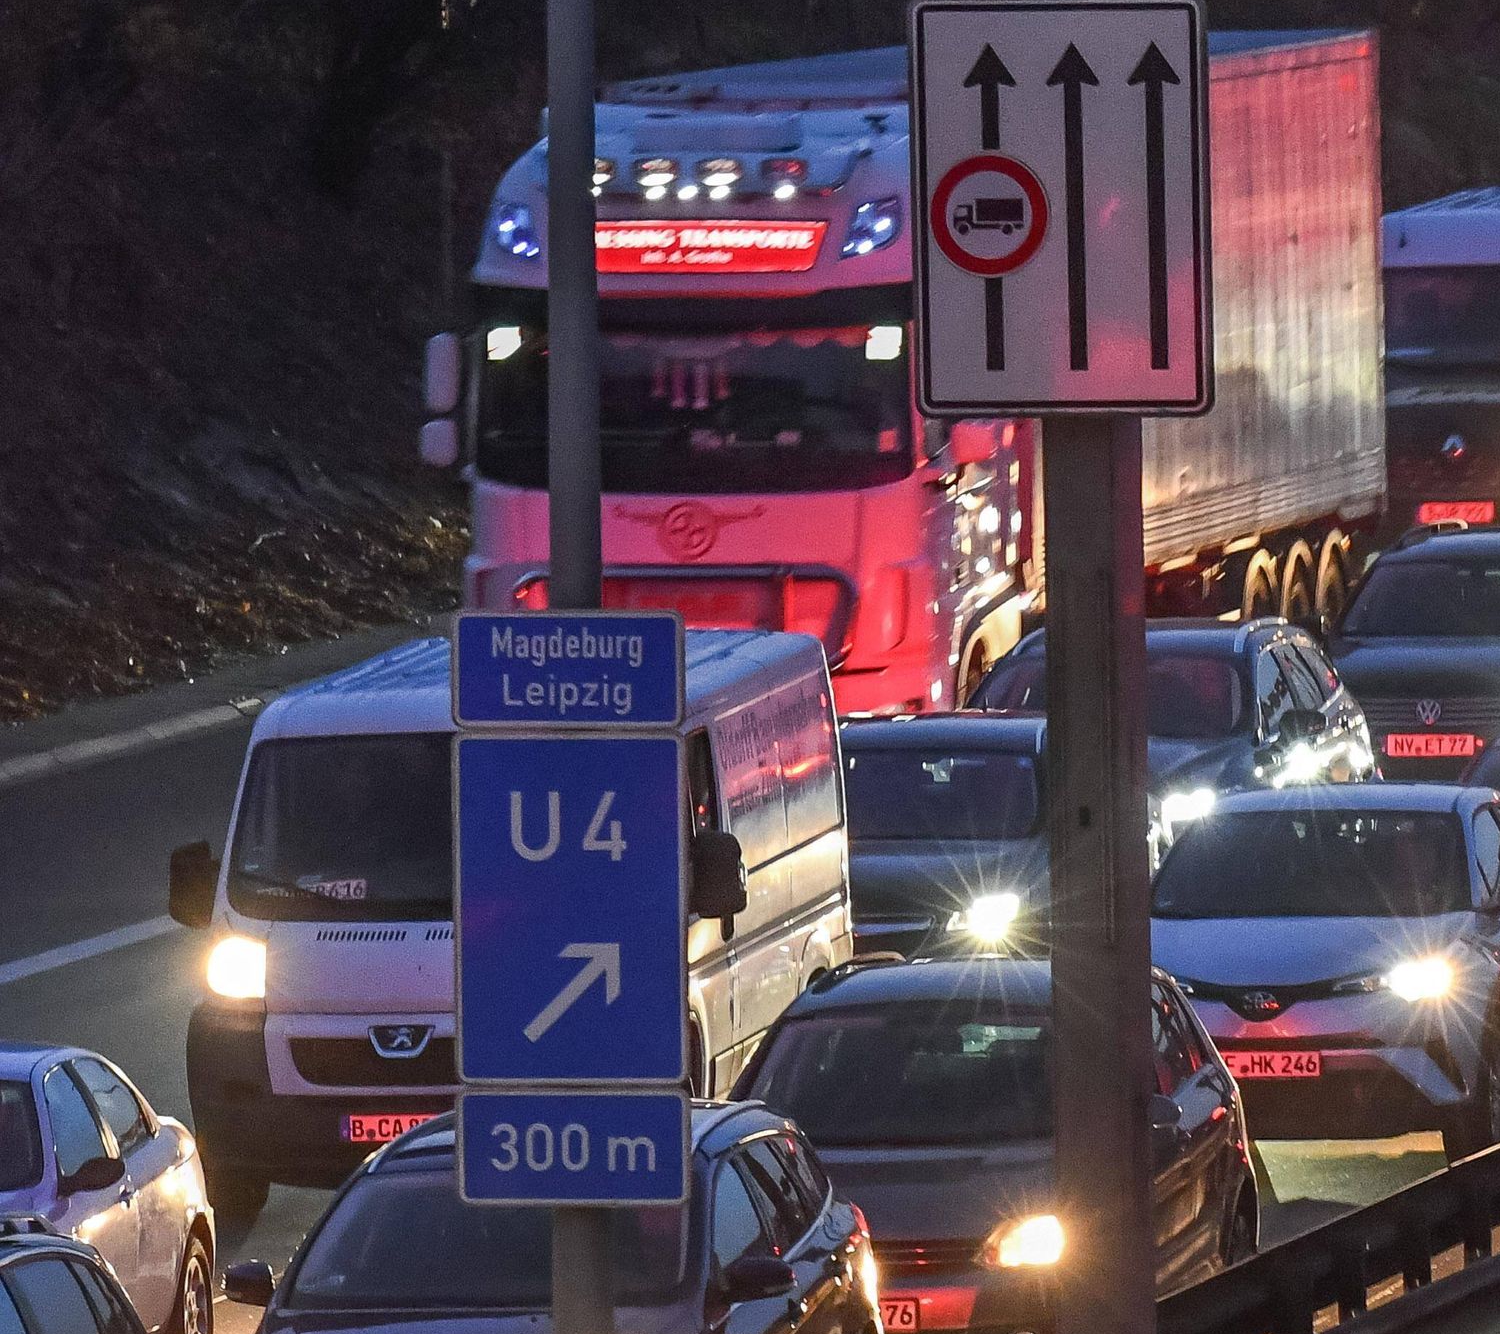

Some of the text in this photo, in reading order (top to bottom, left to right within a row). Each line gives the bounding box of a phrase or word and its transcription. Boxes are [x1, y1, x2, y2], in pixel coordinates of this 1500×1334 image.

[491, 626, 644, 667] Magdeburg
[503, 674, 633, 715] Leipzig
[510, 791, 628, 862] U 4
[1250, 1055, 1276, 1074] HK
[1281, 1055, 1317, 1074] 246
[351, 1119, 365, 1138] B
[377, 1118, 404, 1138] CA
[490, 1123, 656, 1172] 300 m
